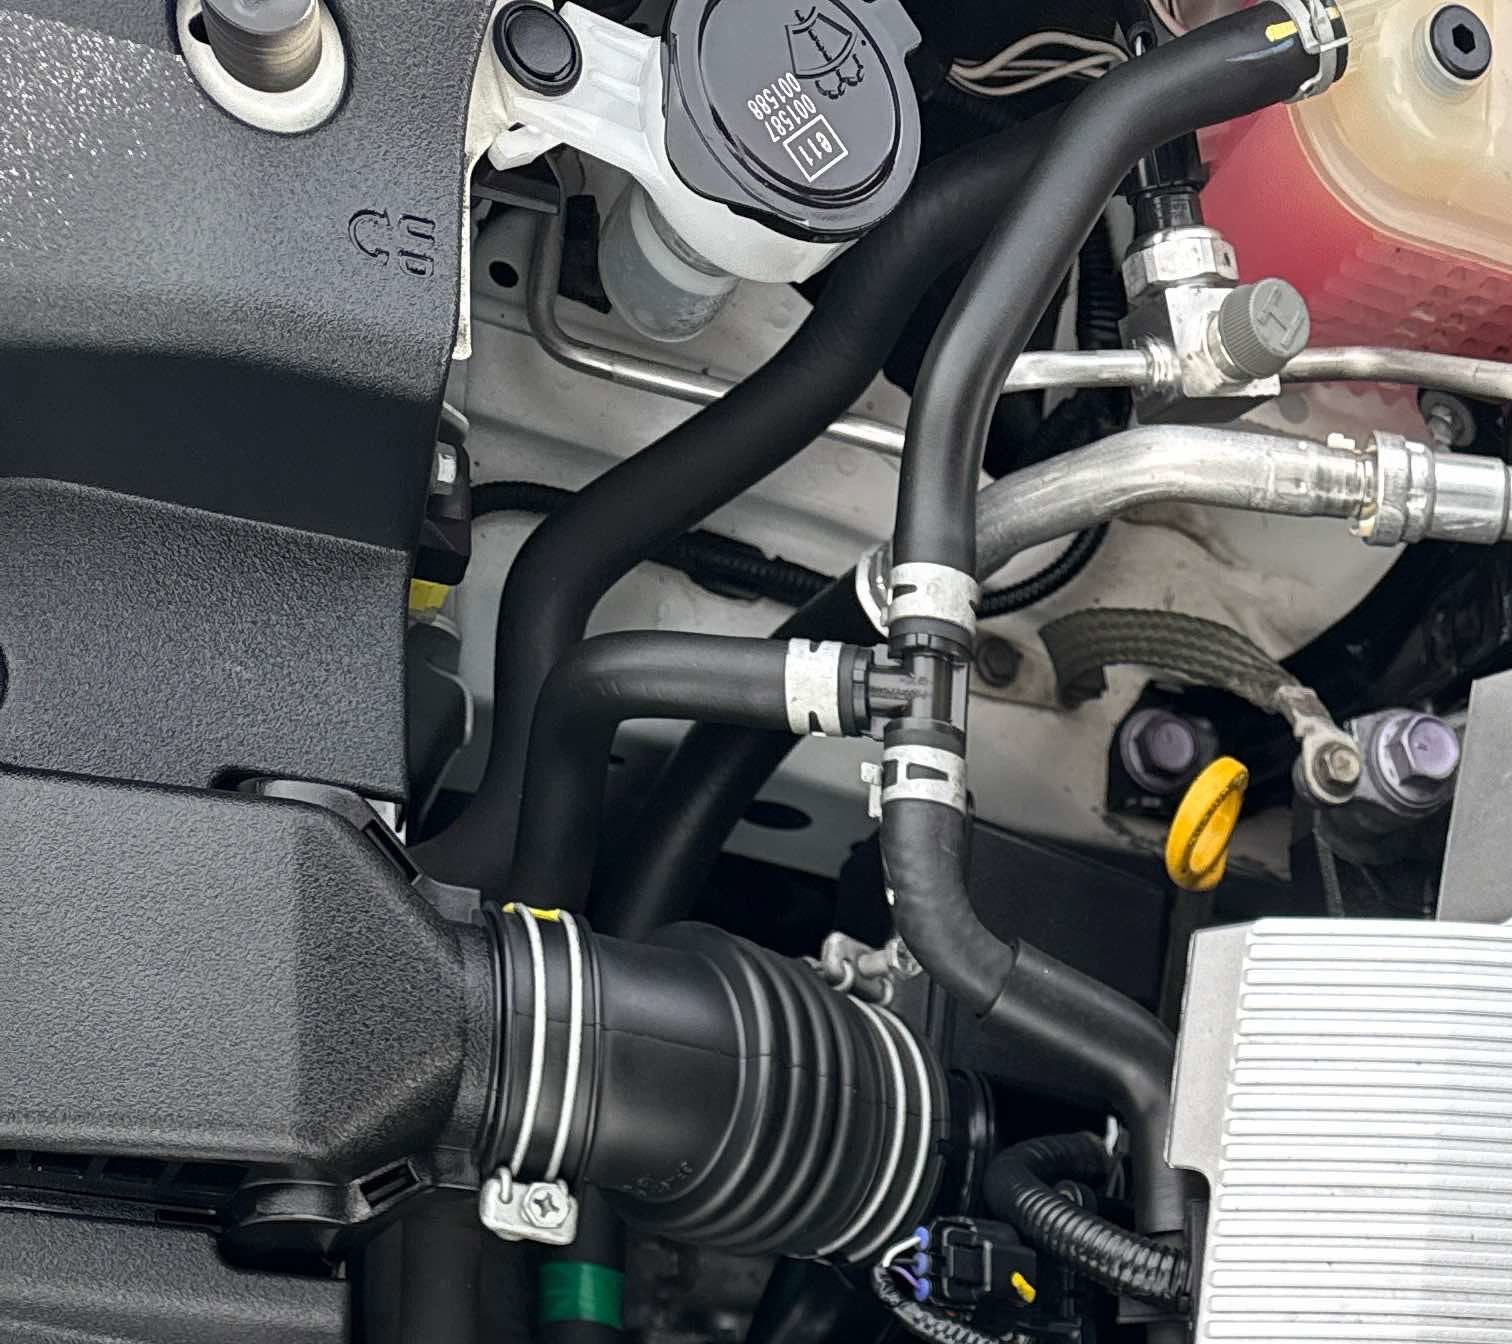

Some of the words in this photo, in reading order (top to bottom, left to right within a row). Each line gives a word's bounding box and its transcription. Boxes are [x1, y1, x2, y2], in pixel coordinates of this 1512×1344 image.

[747, 73, 801, 119] 001588
[763, 94, 817, 142] 001587
[797, 132, 833, 167] e11
